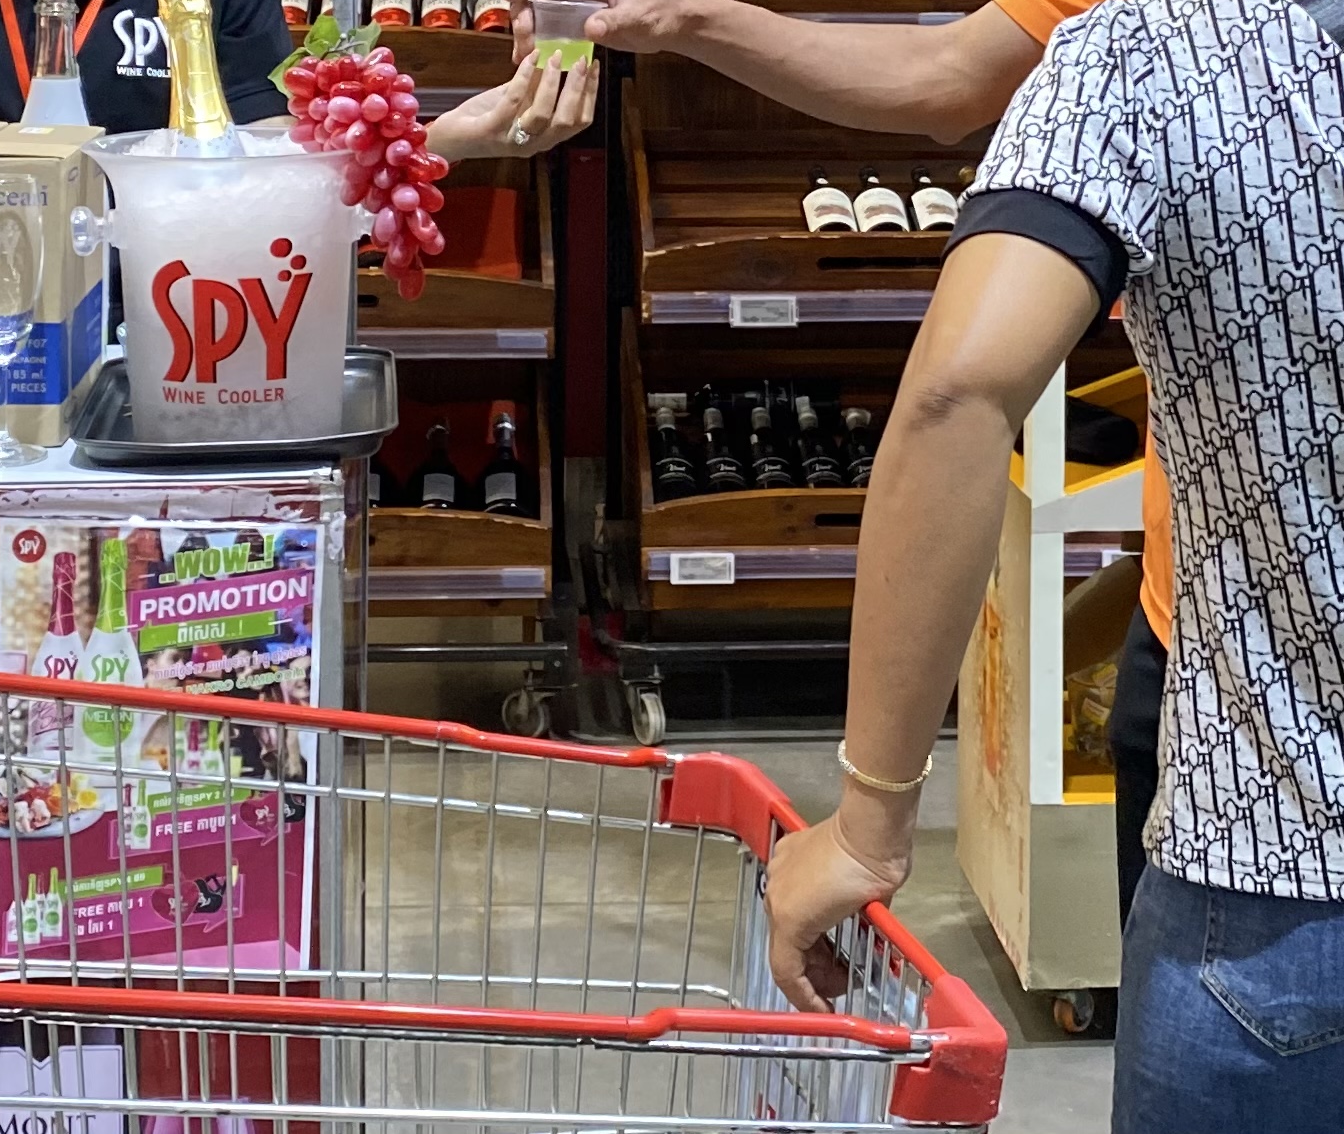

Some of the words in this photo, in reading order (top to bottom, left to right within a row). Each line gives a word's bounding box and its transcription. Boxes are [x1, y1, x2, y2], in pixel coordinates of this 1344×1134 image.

[113, 9, 171, 66] SPY
[117, 66, 142, 77] WINE
[147, 67, 171, 77] COOL
[152, 259, 313, 384] SPY
[11, 383, 47, 393] PIECES
[163, 386, 205, 404] WINE
[218, 387, 285, 404] COOLER
[19, 536, 40, 555] SPY
[140, 576, 308, 622] PROMOTION
[44, 653, 79, 679] SPY
[91, 653, 131, 682] SPY
[85, 711, 132, 723] MELN
[156, 821, 193, 836] FREE
[73, 904, 104, 917] FREE
